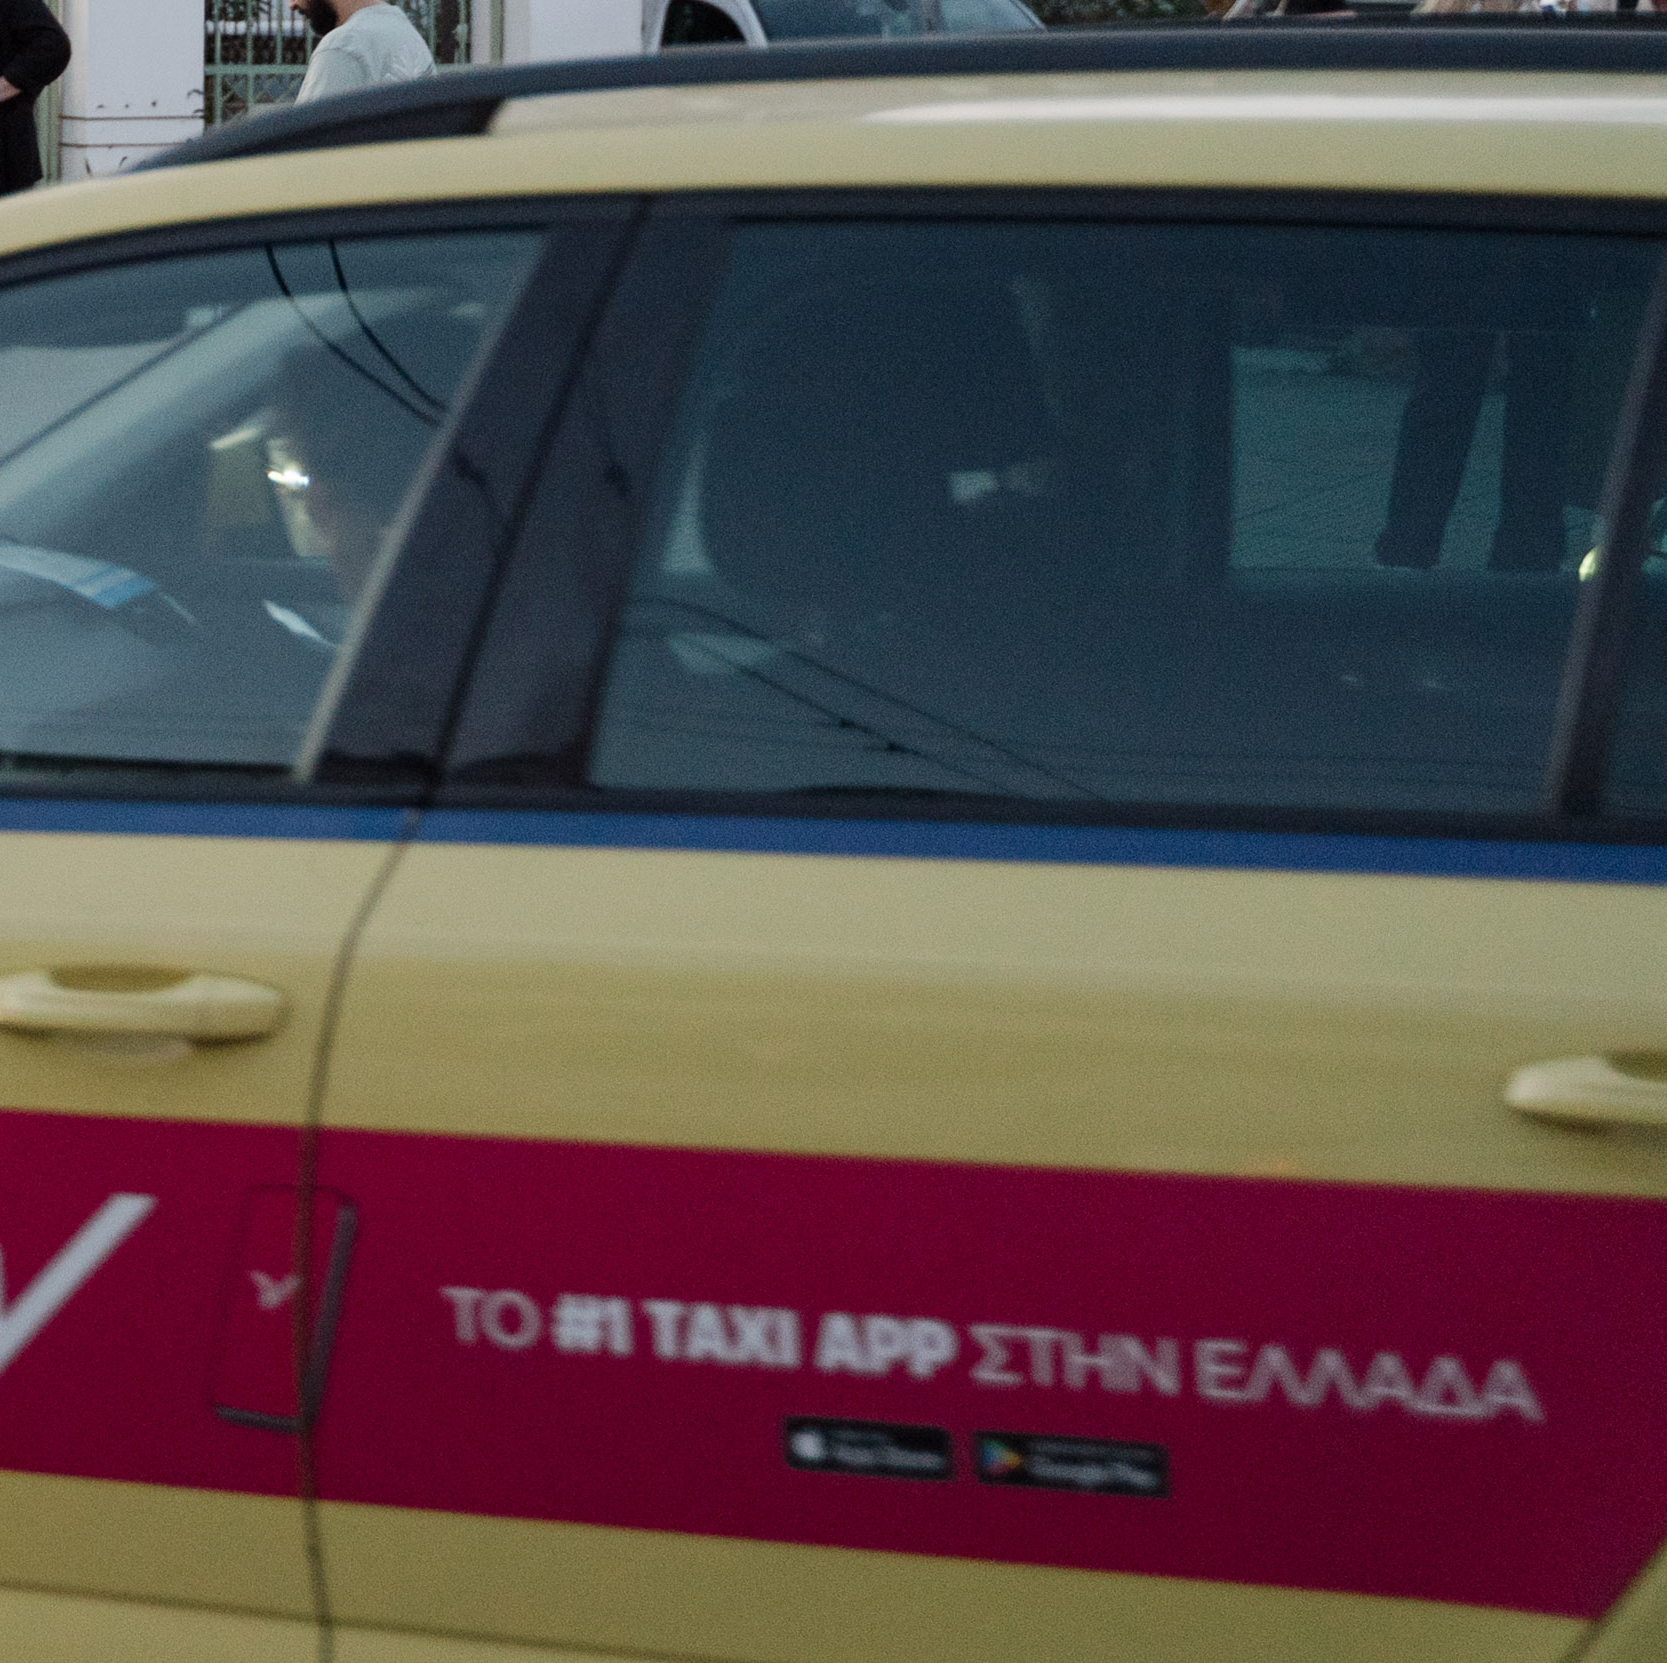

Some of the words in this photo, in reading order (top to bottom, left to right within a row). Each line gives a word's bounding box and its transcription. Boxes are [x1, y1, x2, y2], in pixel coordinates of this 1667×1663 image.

[550, 1291, 635, 1359] #1
[641, 1296, 803, 1370] TAXI
[812, 1310, 961, 1380] APP
[968, 1322, 1183, 1397] ΣΤΗΝ
[1193, 1337, 1546, 1424] ΕΛΛΑΔΑ
